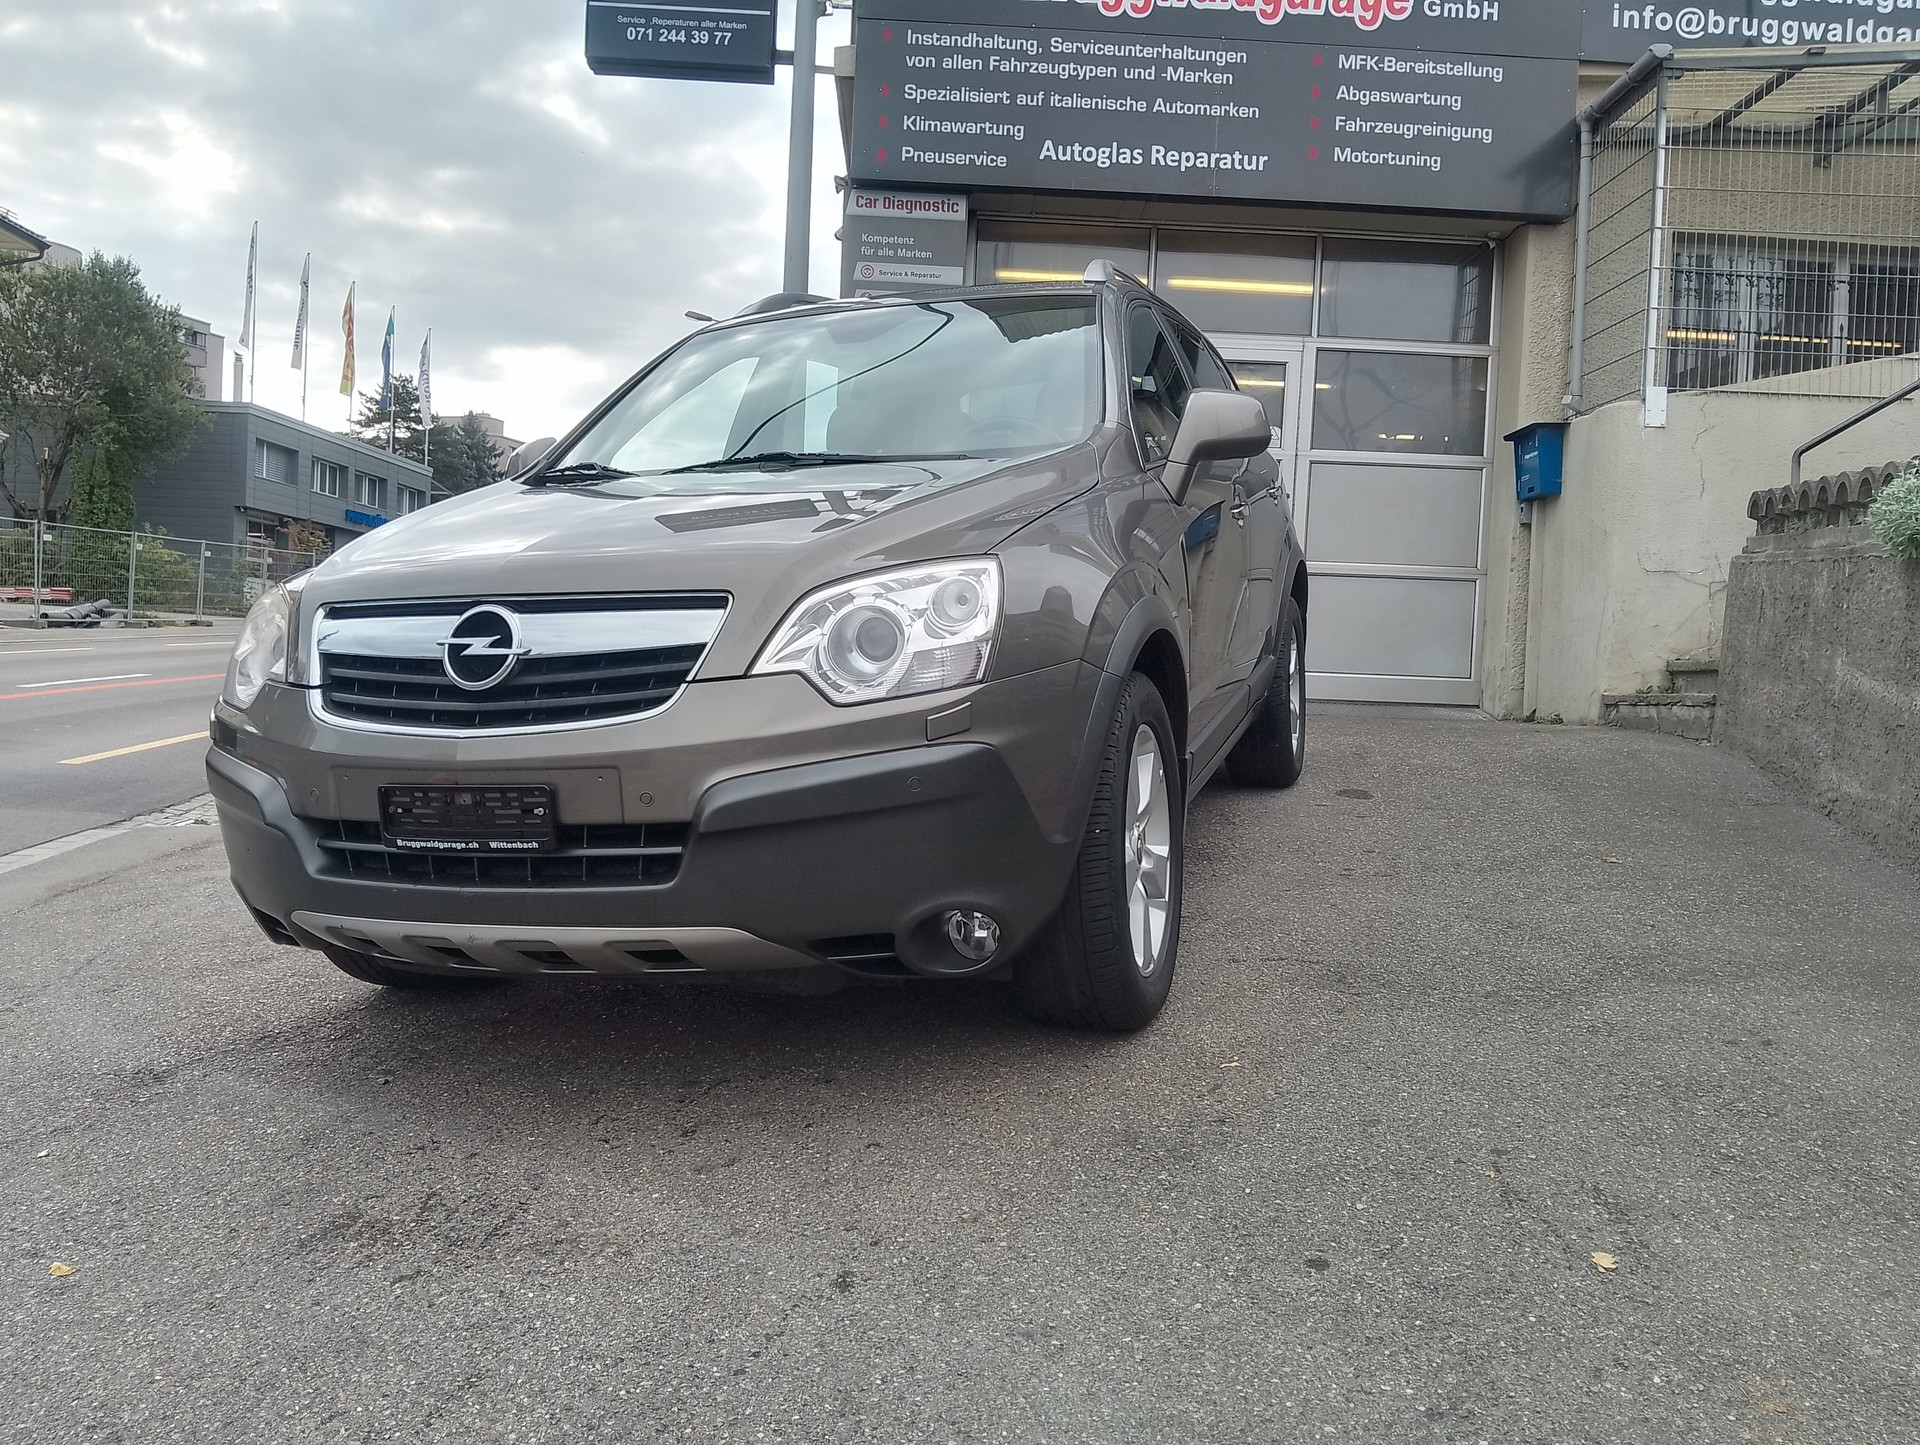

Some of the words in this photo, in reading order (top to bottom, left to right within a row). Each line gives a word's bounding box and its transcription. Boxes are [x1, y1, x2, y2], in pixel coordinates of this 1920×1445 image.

[617, 15, 646, 25] Service
[700, 20, 717, 28] aller
[719, 21, 748, 30] Marken
[1423, 0, 1499, 21] GmbH
[1612, 3, 1920, 45] info@bruggwaldga
[627, 27, 653, 41] 071
[659, 28, 687, 43] 244
[690, 30, 709, 44] 39
[714, 32, 733, 46] 77
[907, 29, 1043, 55] Instandhaltung,
[1050, 37, 1248, 66] Serviceunterhaltungen
[905, 55, 936, 68] von
[942, 54, 983, 71] allen
[989, 56, 1118, 80] Fahrzeugtypen
[1124, 65, 1155, 80] und
[1161, 67, 1234, 85] -Marken
[1338, 54, 1503, 82] MFK-Bereitstellung
[904, 84, 1011, 104] Spezialisiert
[1016, 91, 1045, 107] auf
[1050, 92, 1148, 112] italienische
[1153, 98, 1260, 119] Automarken
[1336, 85, 1462, 110] Abgaswartung
[902, 115, 1025, 141] Klimawartung
[1335, 116, 1493, 143] Fahrzeugreinigung
[901, 146, 1008, 167] Pneuservice
[1039, 140, 1144, 168] Autoglas
[1151, 145, 1269, 172] Reparatur
[1333, 147, 1441, 171] Motortuning
[855, 195, 879, 208] Car
[882, 196, 960, 214] Diagnostic
[861, 233, 915, 245] Kompetenz
[860, 246, 875, 255] für
[877, 248, 895, 257] alle
[897, 248, 933, 258] Marken
[878, 269, 903, 277] Service
[904, 269, 909, 277] &
[910, 270, 942, 279] Reparatur
[396, 839, 480, 849] Bruggwaldgarage.ch
[488, 841, 540, 849] Wittenbach
